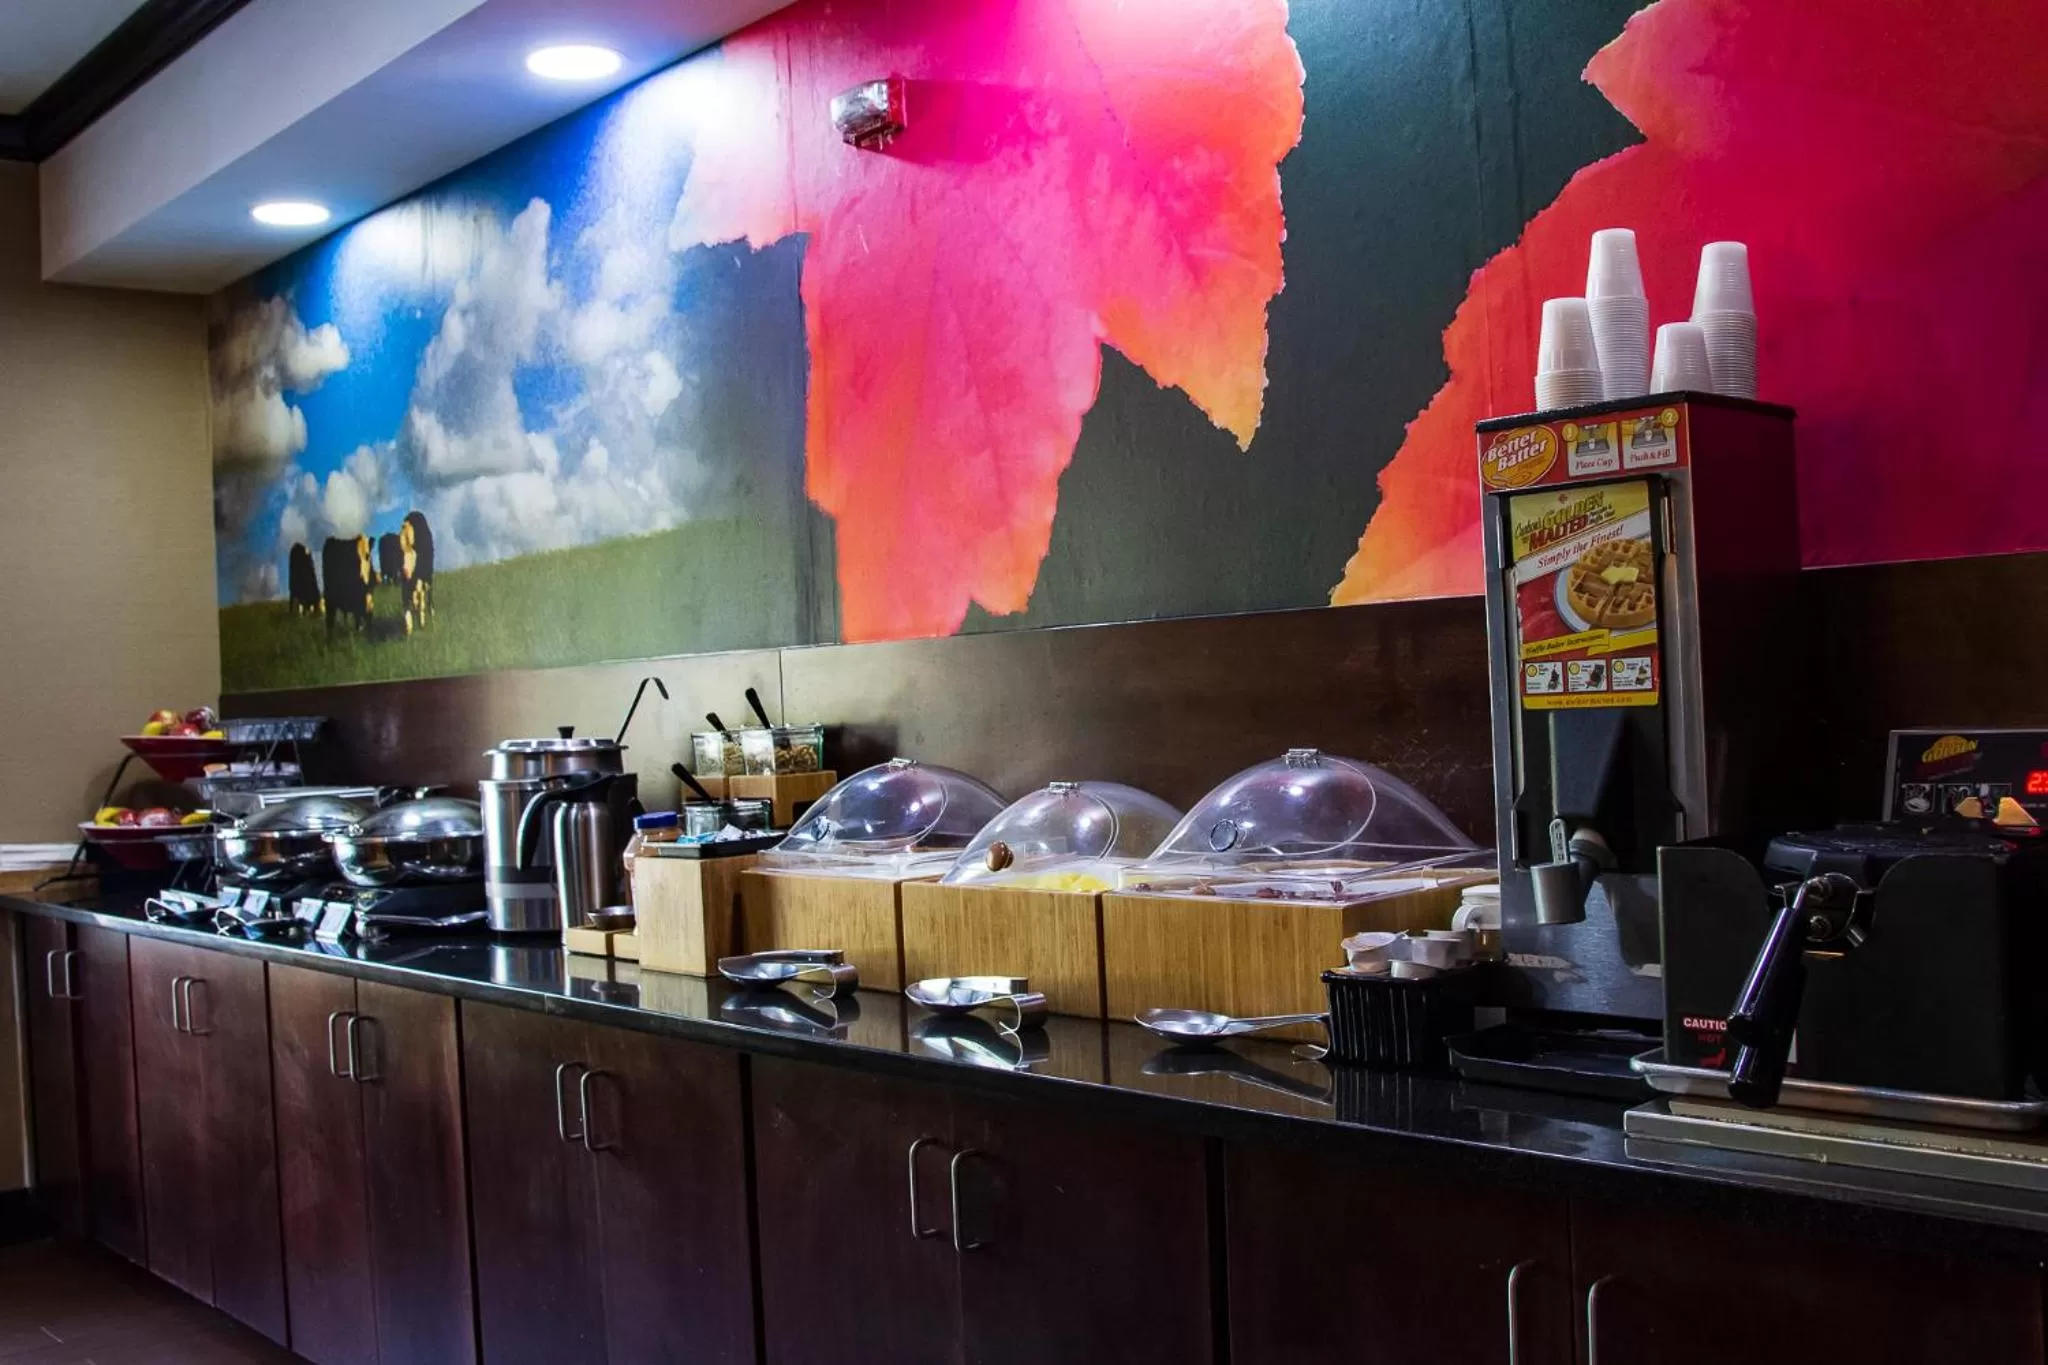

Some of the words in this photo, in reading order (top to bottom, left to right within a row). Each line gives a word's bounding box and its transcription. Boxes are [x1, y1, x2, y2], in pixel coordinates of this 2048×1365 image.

[1487, 430, 1537, 462] Better
[1498, 440, 1548, 472] Batter
[1597, 458, 1613, 468] Cup
[1529, 514, 1589, 552] MALTED
[1538, 547, 1571, 568] Simply
[1573, 541, 1588, 555] the
[1591, 524, 1624, 546] Finest!
[1683, 1017, 1728, 1031] CAUTIO
